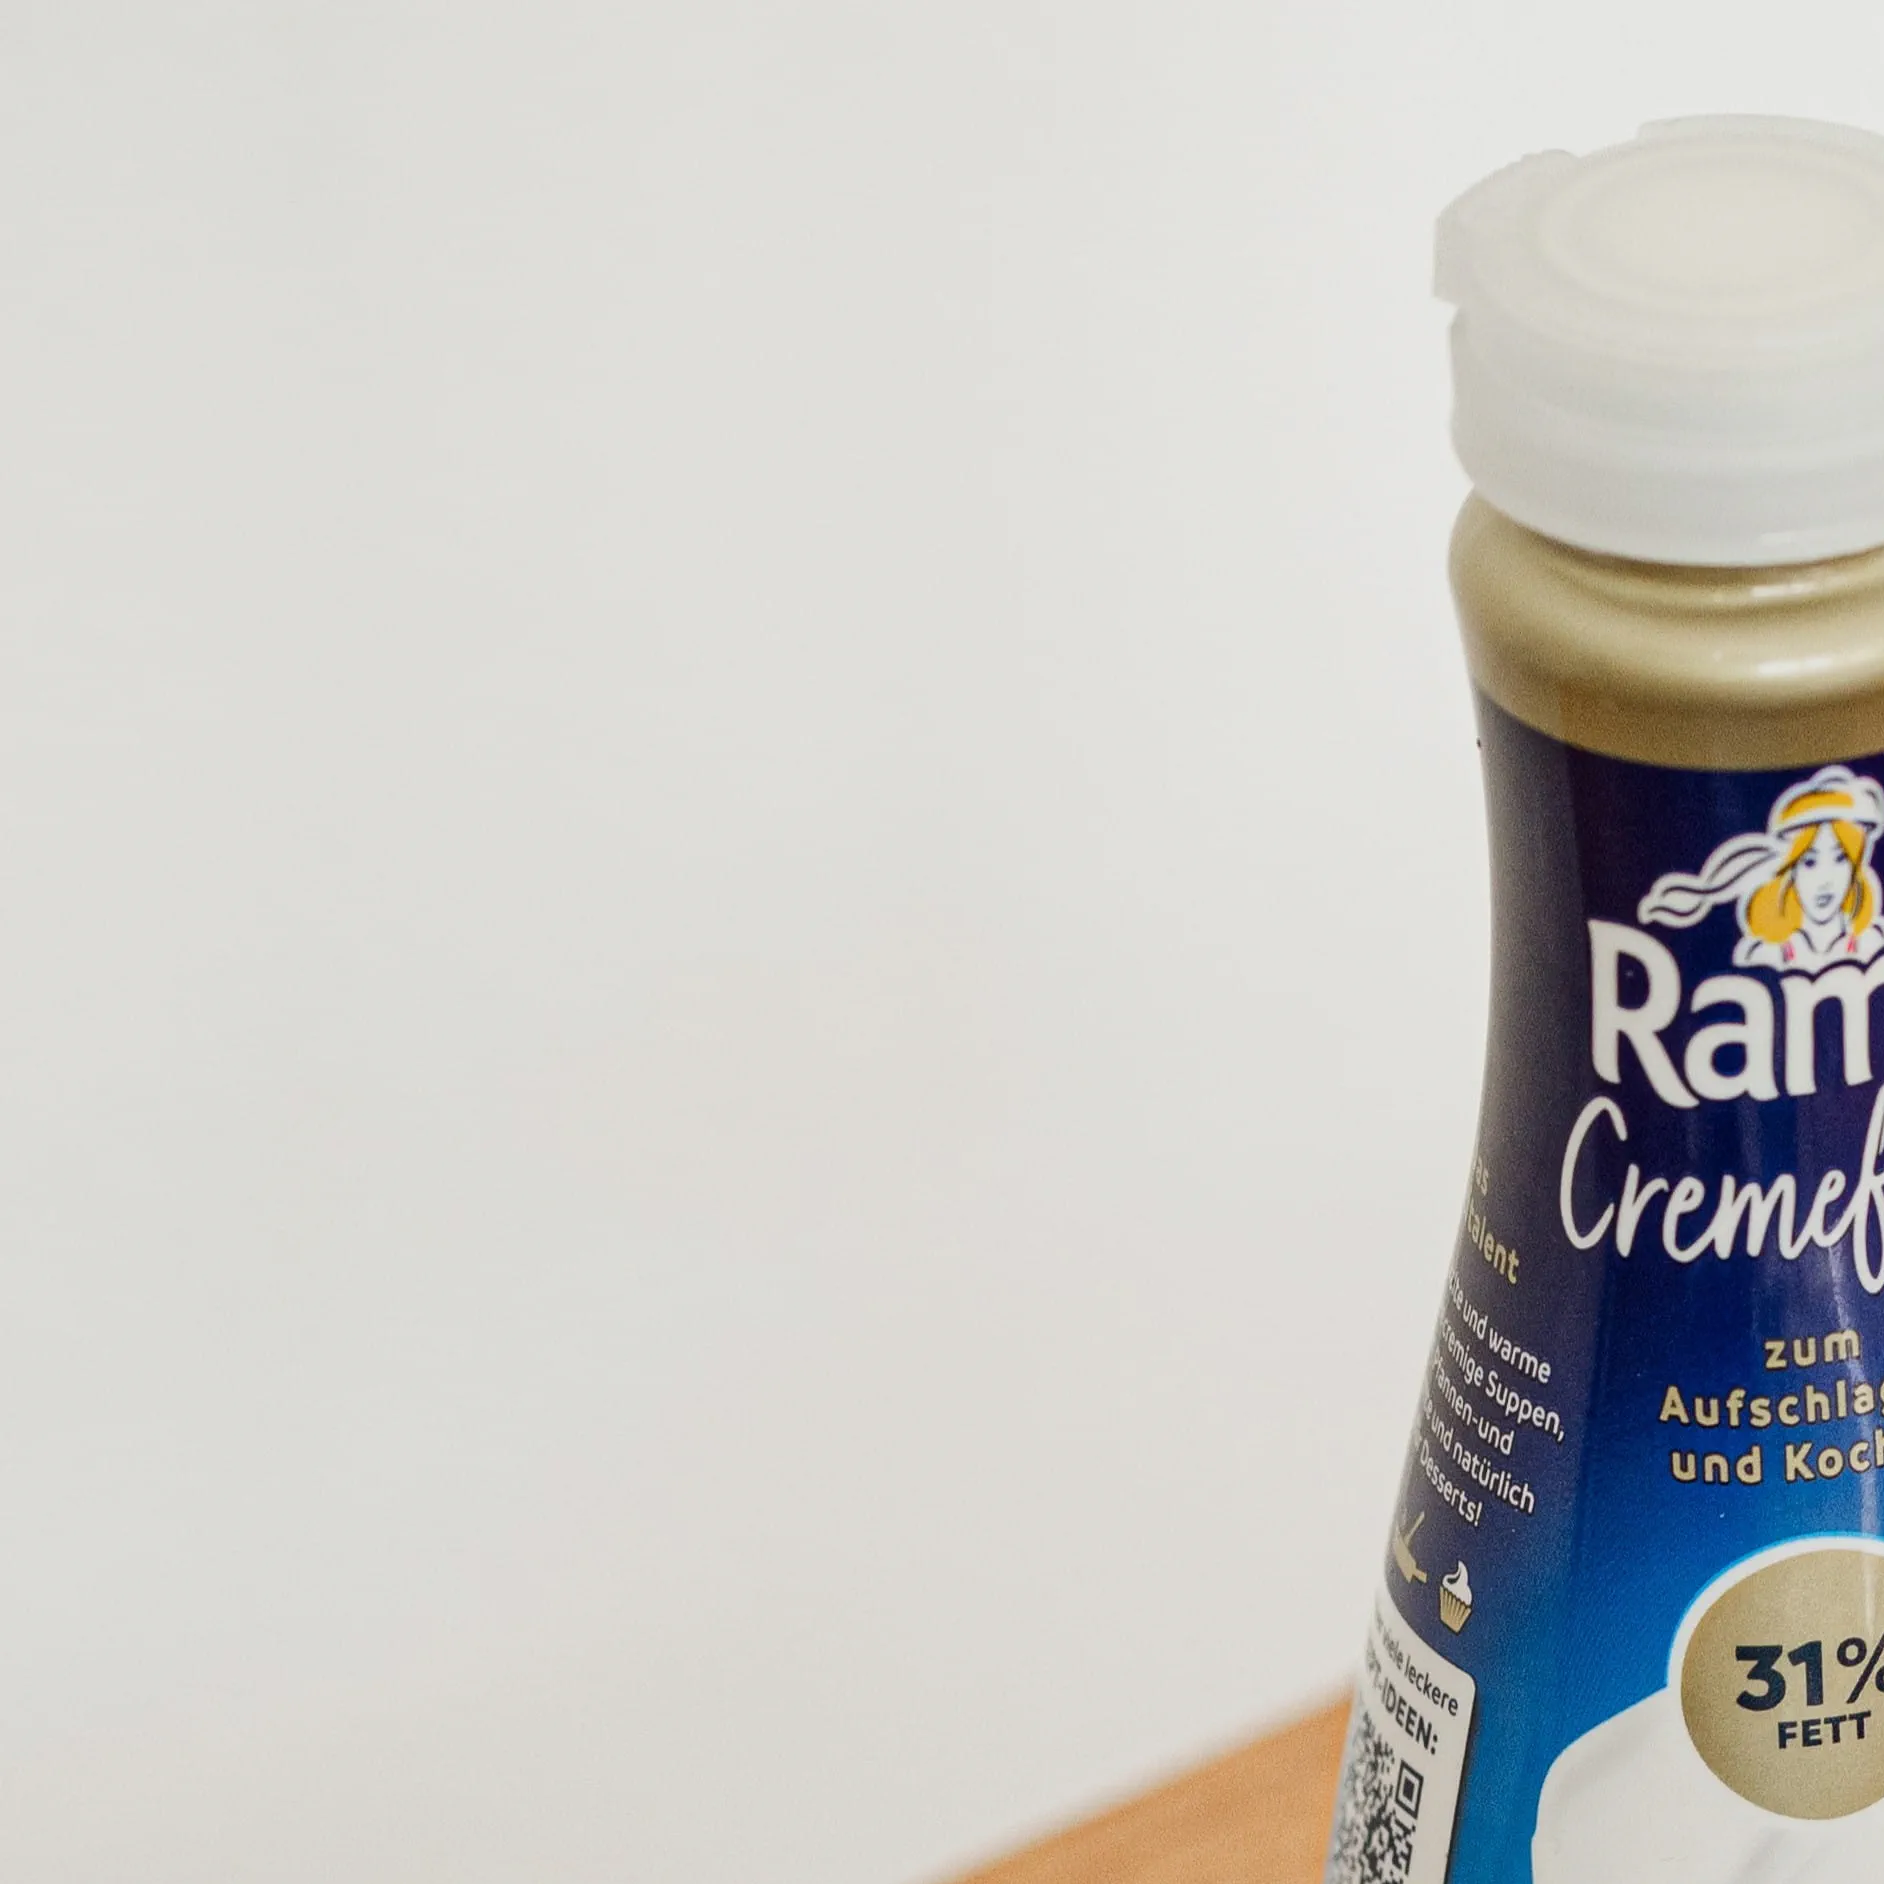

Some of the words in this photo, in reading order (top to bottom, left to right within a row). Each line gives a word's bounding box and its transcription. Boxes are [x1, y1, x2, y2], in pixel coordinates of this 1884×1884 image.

[1463, 1299, 1488, 1340] und
[1489, 1327, 1551, 1384] warme
[1764, 1328, 1860, 1370] zum
[1485, 1369, 1565, 1442] Suppen,
[1419, 1439, 1483, 1527] Desserts!
[1430, 1404, 1454, 1452] und
[1452, 1441, 1535, 1514] natürlich
[1671, 1445, 1763, 1485] und
[1404, 1655, 1459, 1717] leckere
[1777, 1709, 1872, 1750] FETT
